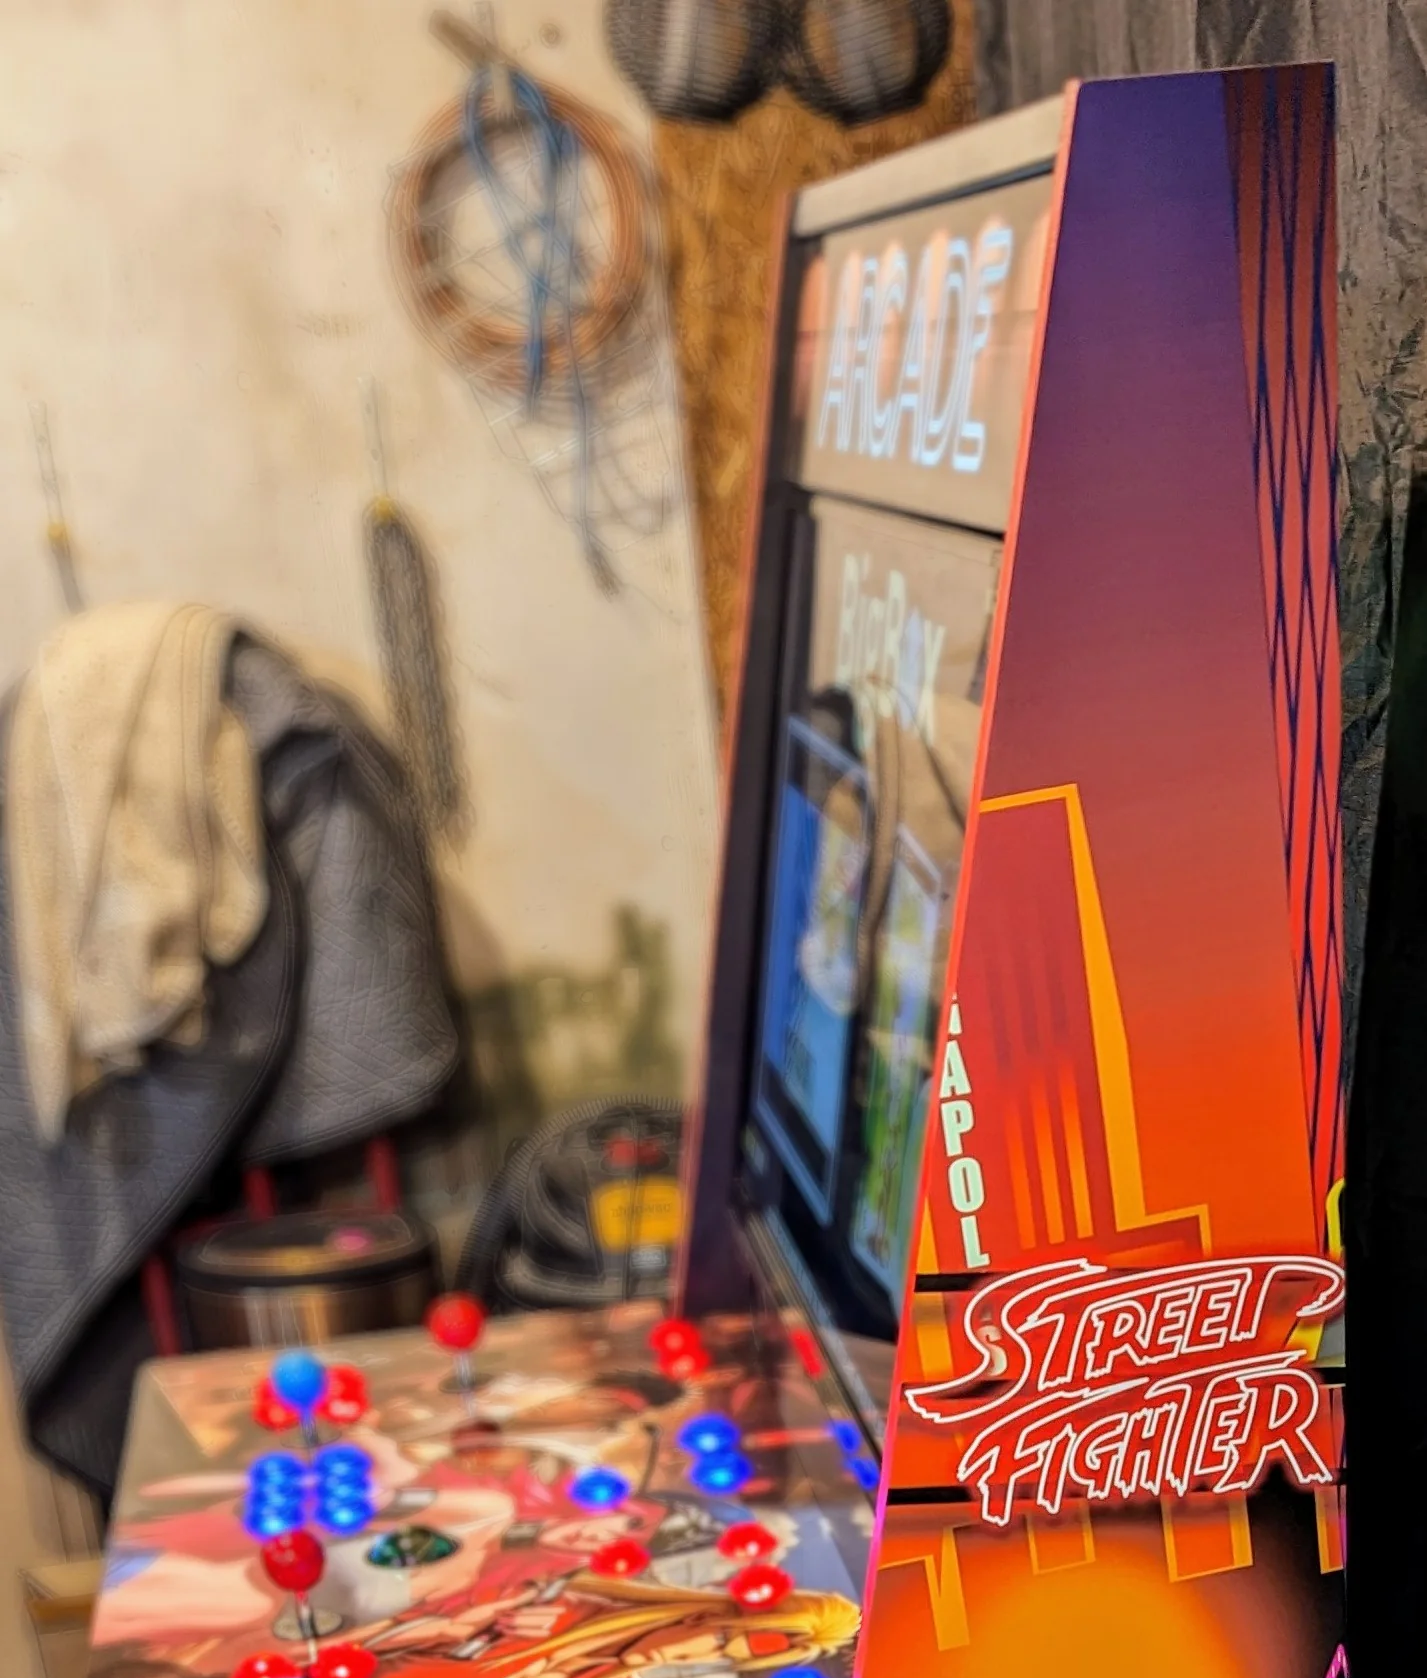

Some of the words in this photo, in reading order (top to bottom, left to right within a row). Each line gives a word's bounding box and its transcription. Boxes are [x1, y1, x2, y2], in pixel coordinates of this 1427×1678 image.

[818, 226, 1012, 472] ARCADE
[905, 1256, 1345, 1422] STREET
[957, 1350, 1332, 1526] FIGHTER
